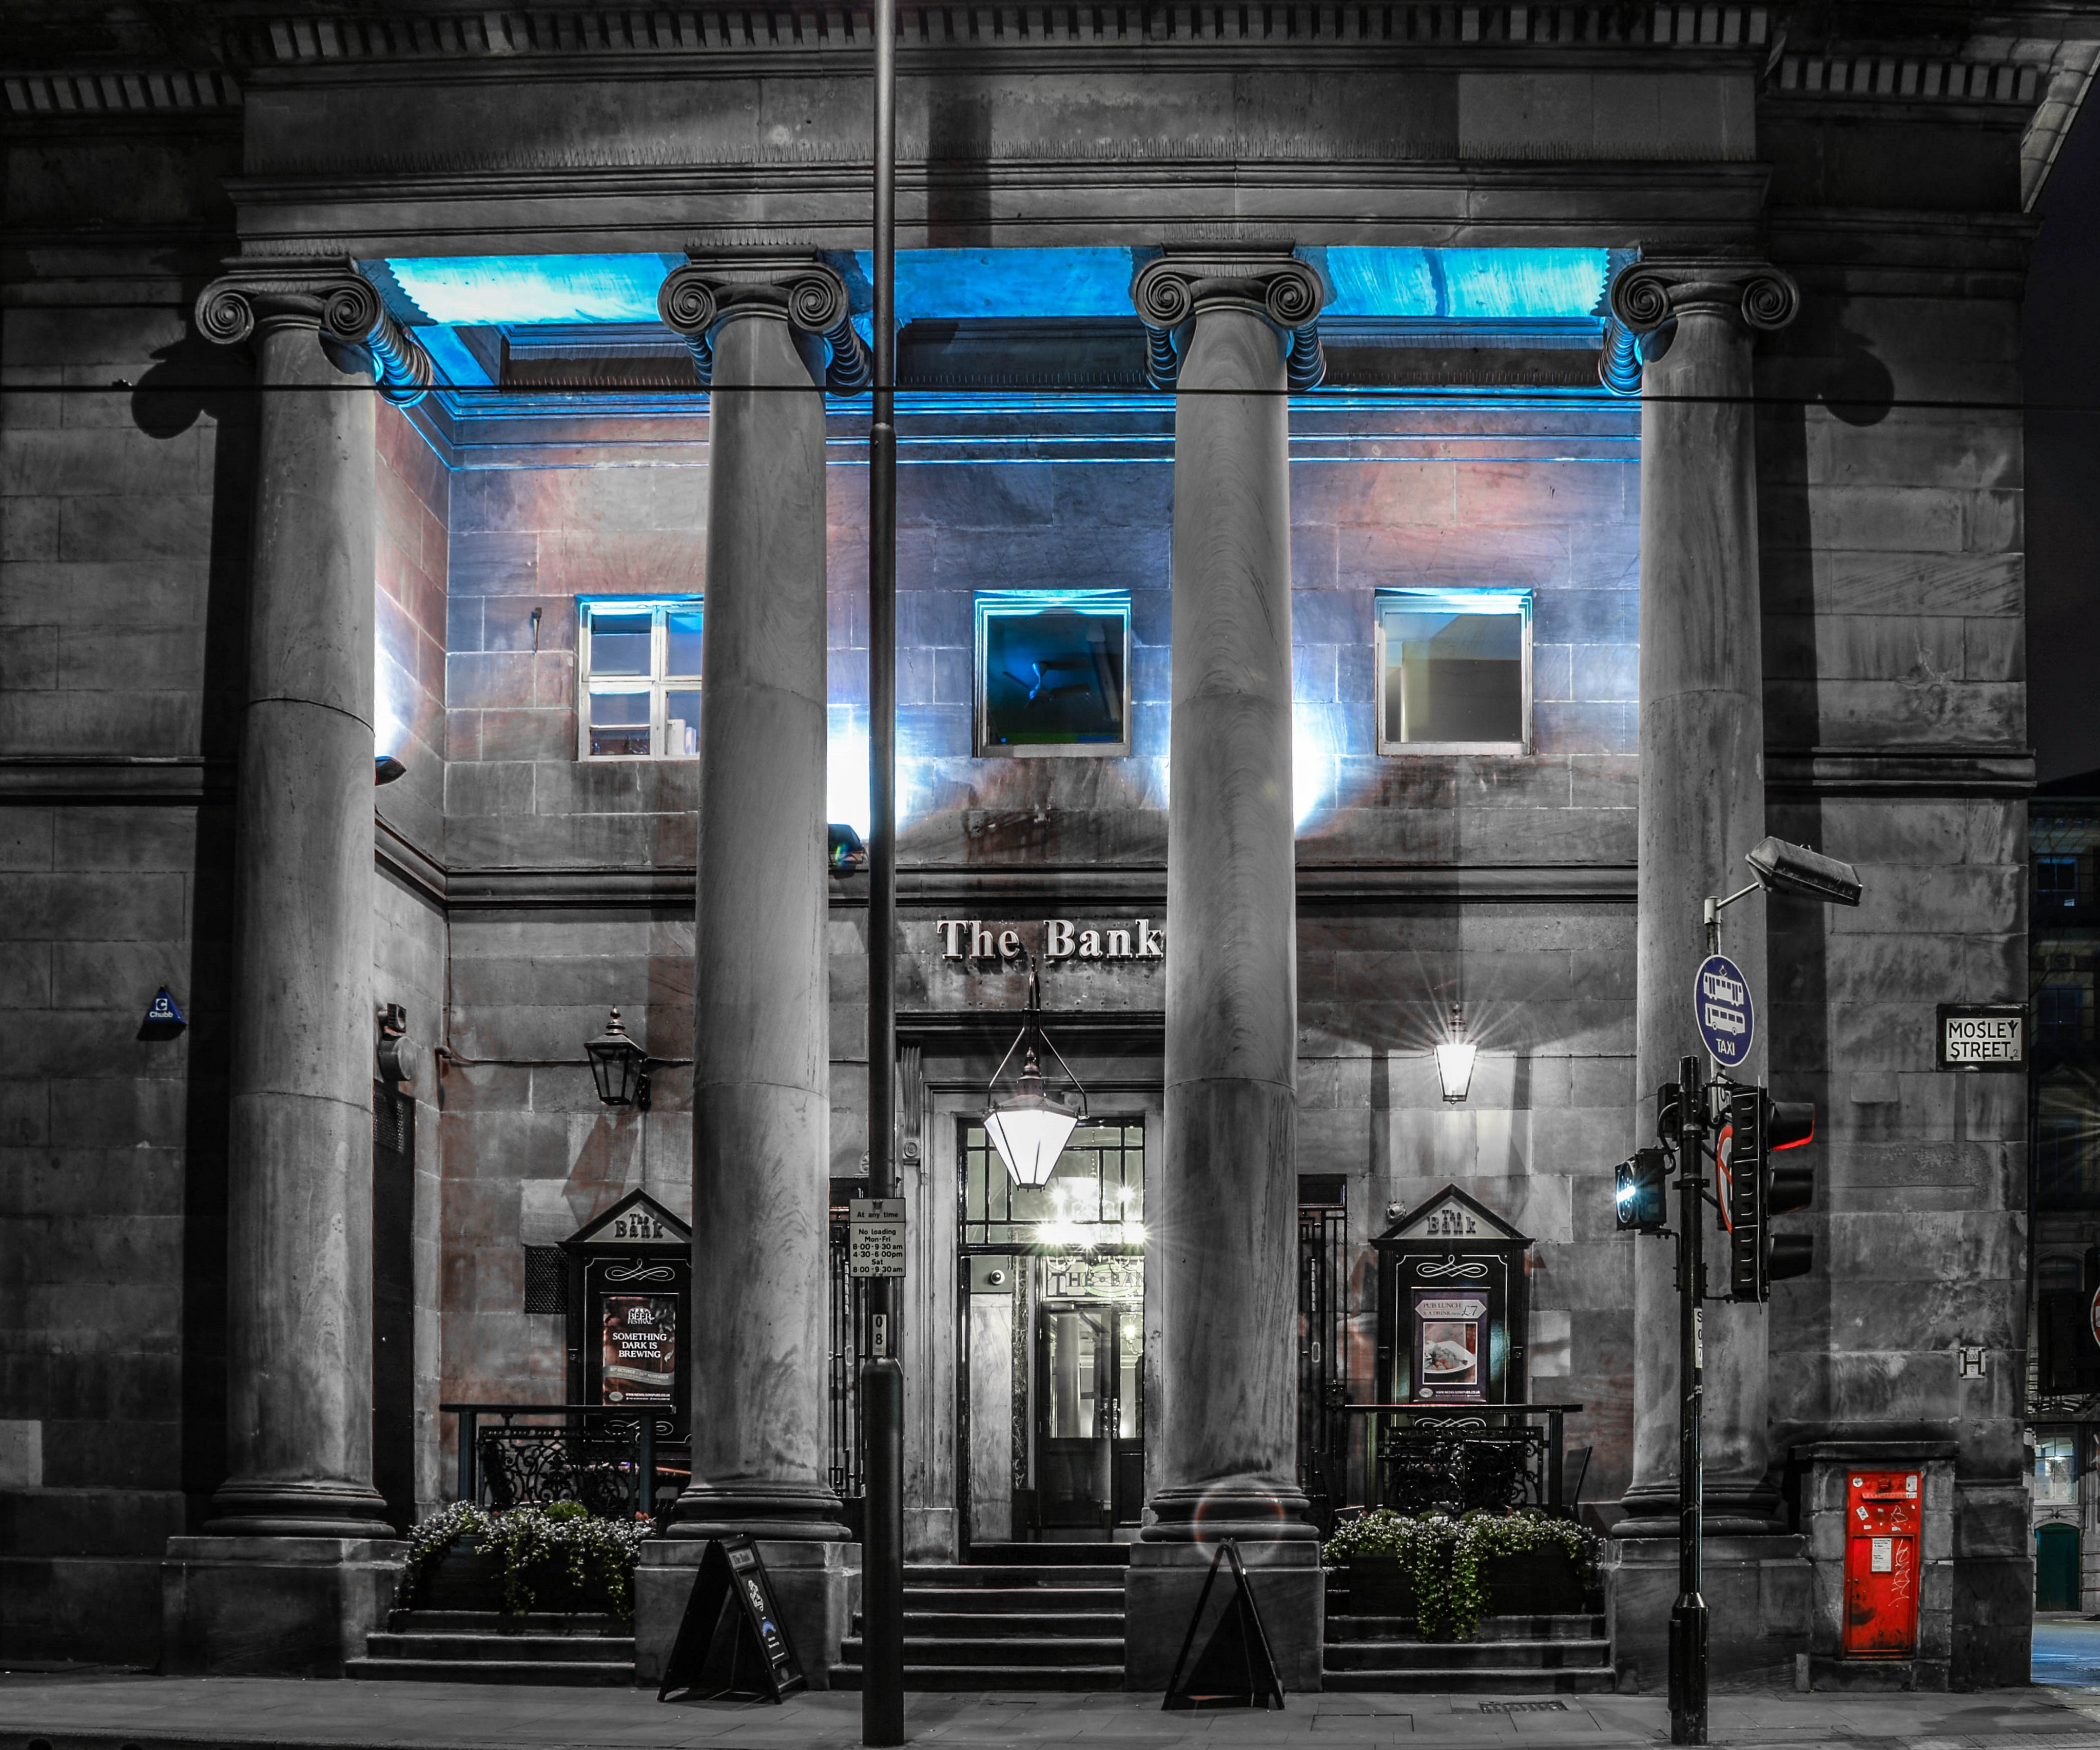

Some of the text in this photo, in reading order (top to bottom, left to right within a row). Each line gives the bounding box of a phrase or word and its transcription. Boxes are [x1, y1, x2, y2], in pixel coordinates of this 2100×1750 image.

[937, 919, 1164, 959] The Bank
[1949, 1021, 2019, 1039] MOSLEY
[1716, 1038, 1736, 1056] TAXI
[1950, 1041, 2011, 1058] STREET
[629, 1213, 649, 1225] The
[1442, 1210, 1462, 1222] The
[614, 1220, 664, 1239] Bank
[1427, 1216, 1476, 1235] Bank
[628, 1309, 655, 1320] BEER
[1462, 1305, 1477, 1316] £7
[612, 1332, 667, 1341] SOMETHING
